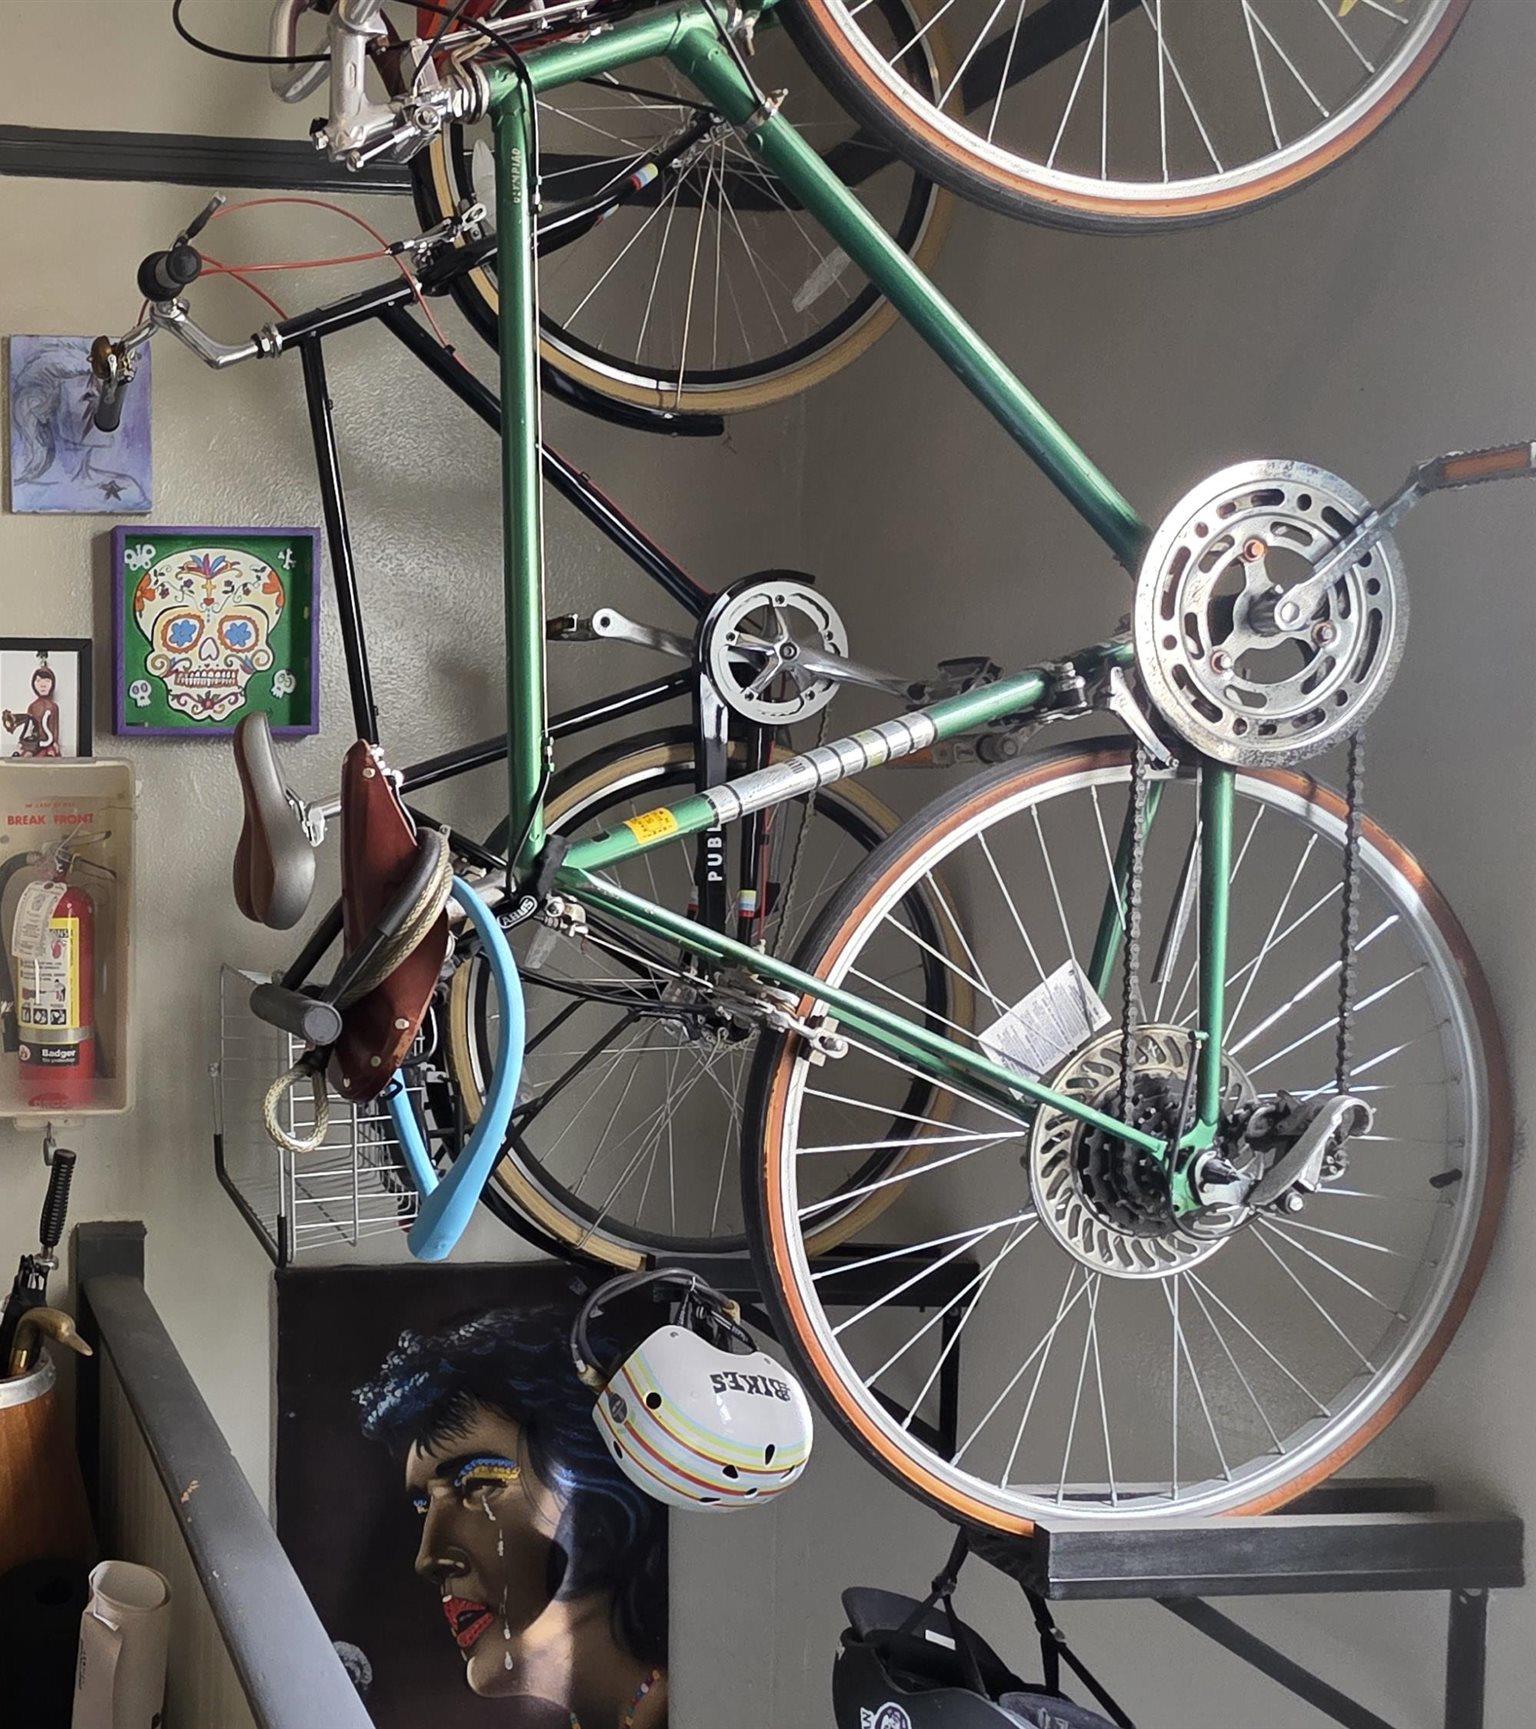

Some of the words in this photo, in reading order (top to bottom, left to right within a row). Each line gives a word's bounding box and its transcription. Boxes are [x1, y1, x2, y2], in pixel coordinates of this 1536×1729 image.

[7, 814, 46, 825] BREAK
[53, 812, 94, 824] FRONT
[500, 897, 535, 927] ABUS
[41, 1049, 76, 1059] Badger
[709, 1371, 792, 1402] BIKES
